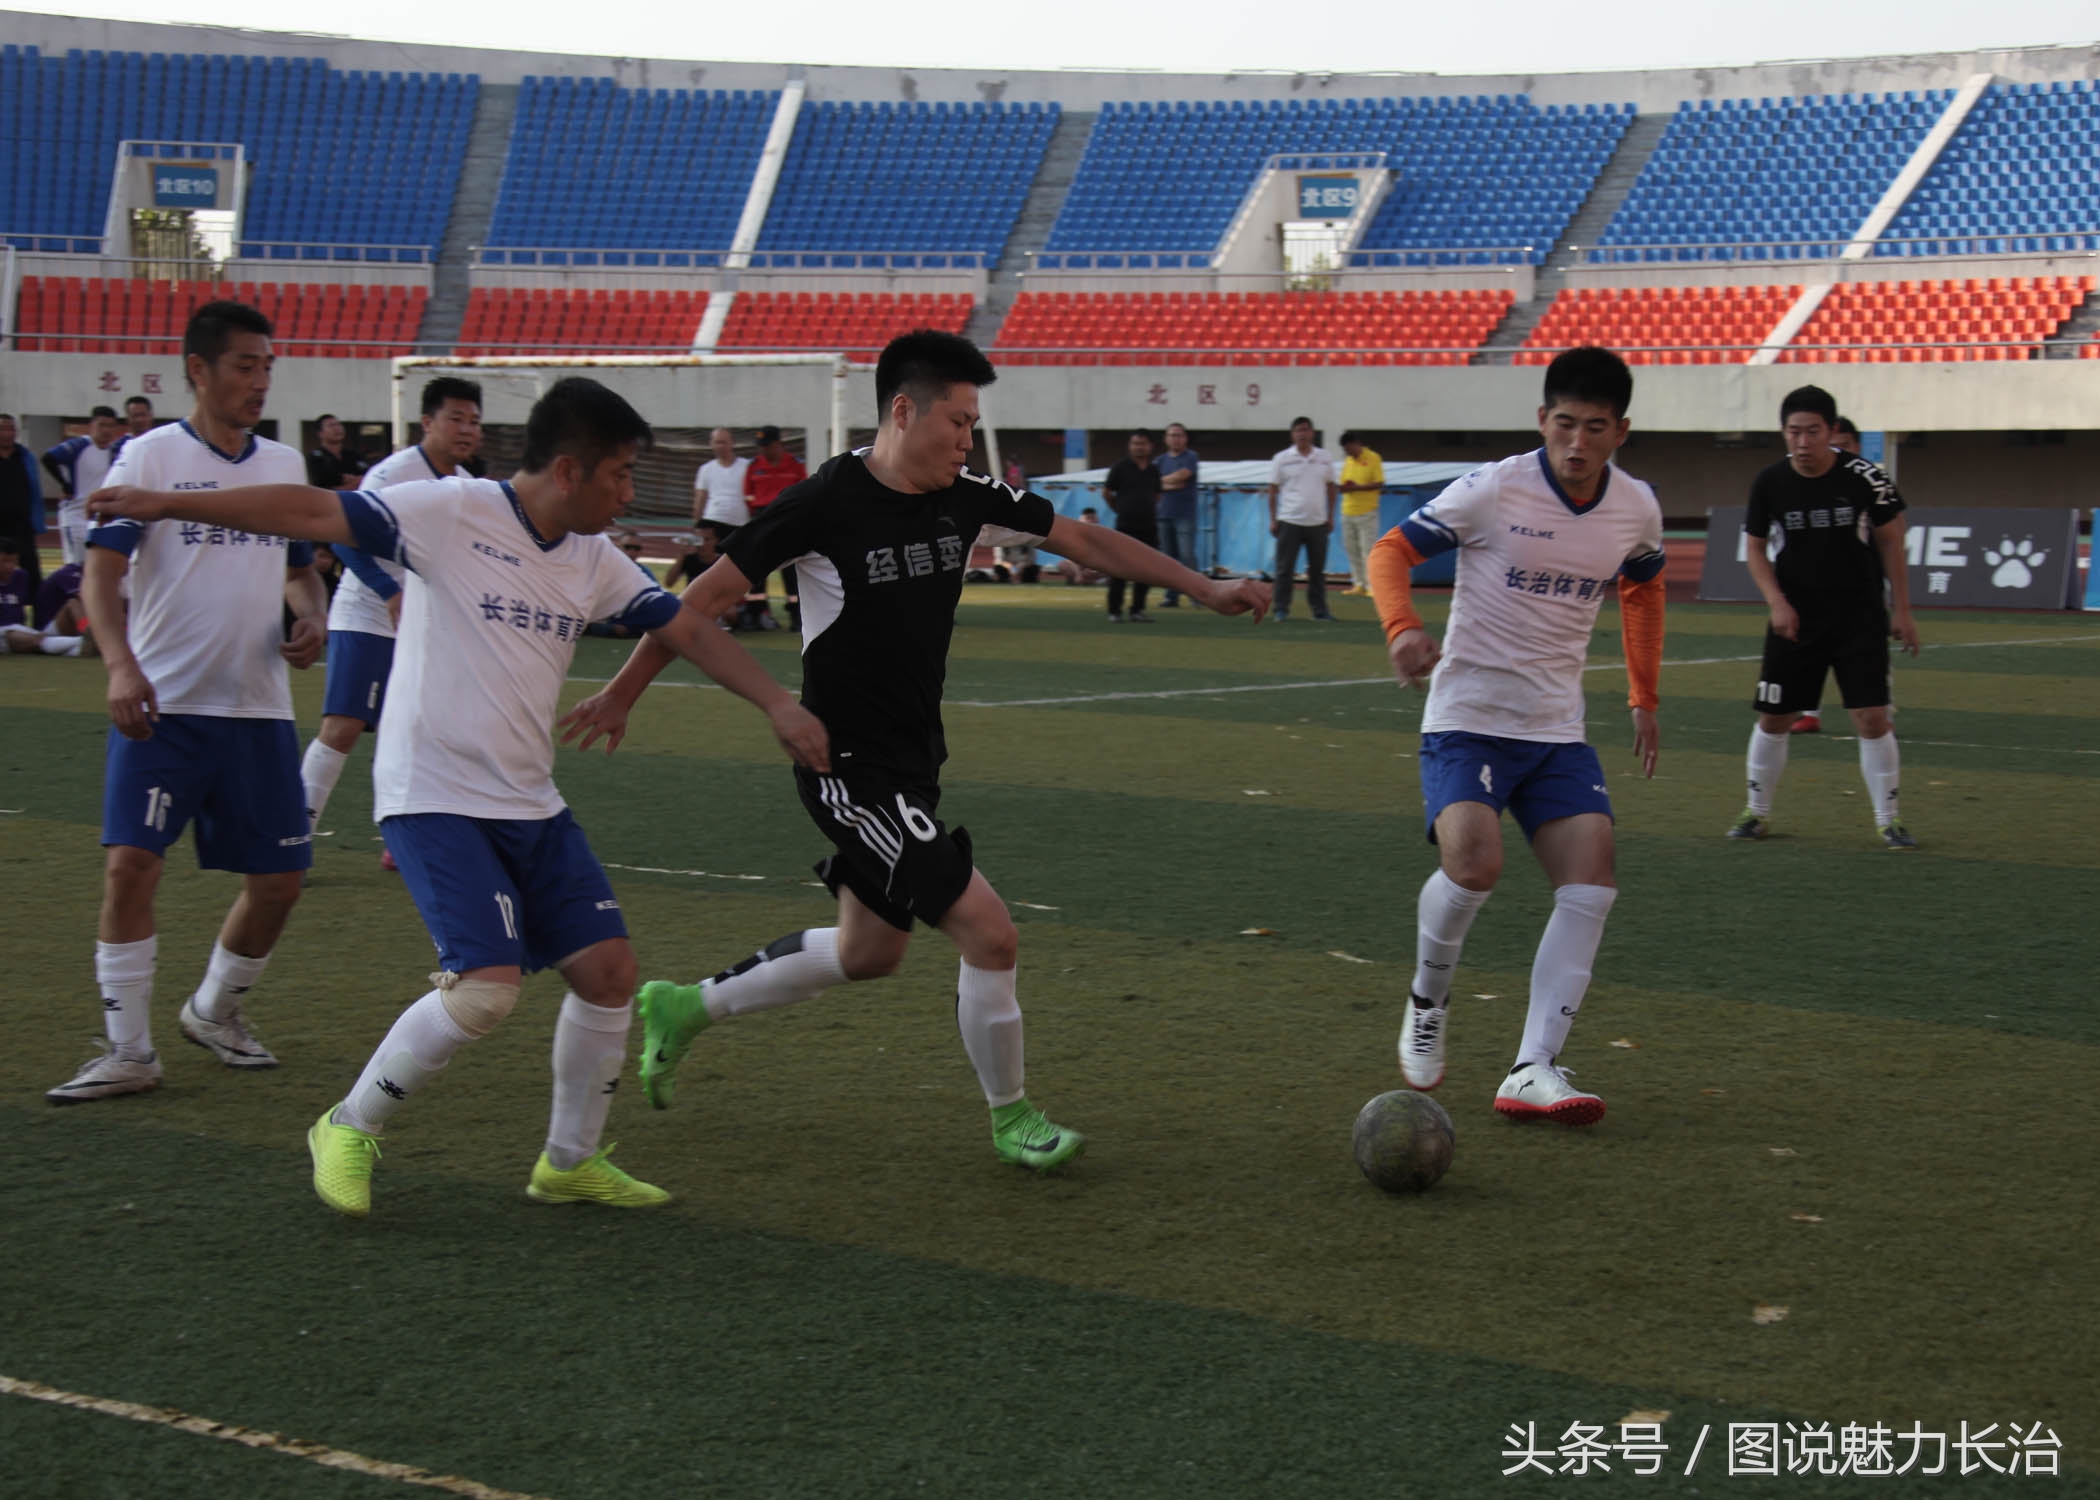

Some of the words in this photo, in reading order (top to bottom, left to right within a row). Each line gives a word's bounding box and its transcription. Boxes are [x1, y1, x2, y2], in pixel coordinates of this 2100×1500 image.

[1301, 187, 1357, 208] 北区9
[173, 481, 220, 490] KELME
[1509, 524, 1556, 540] KELME
[472, 541, 521, 567] KELME
[866, 535, 963, 584] 经信委
[1757, 681, 1782, 704] 10
[895, 793, 937, 842] 6
